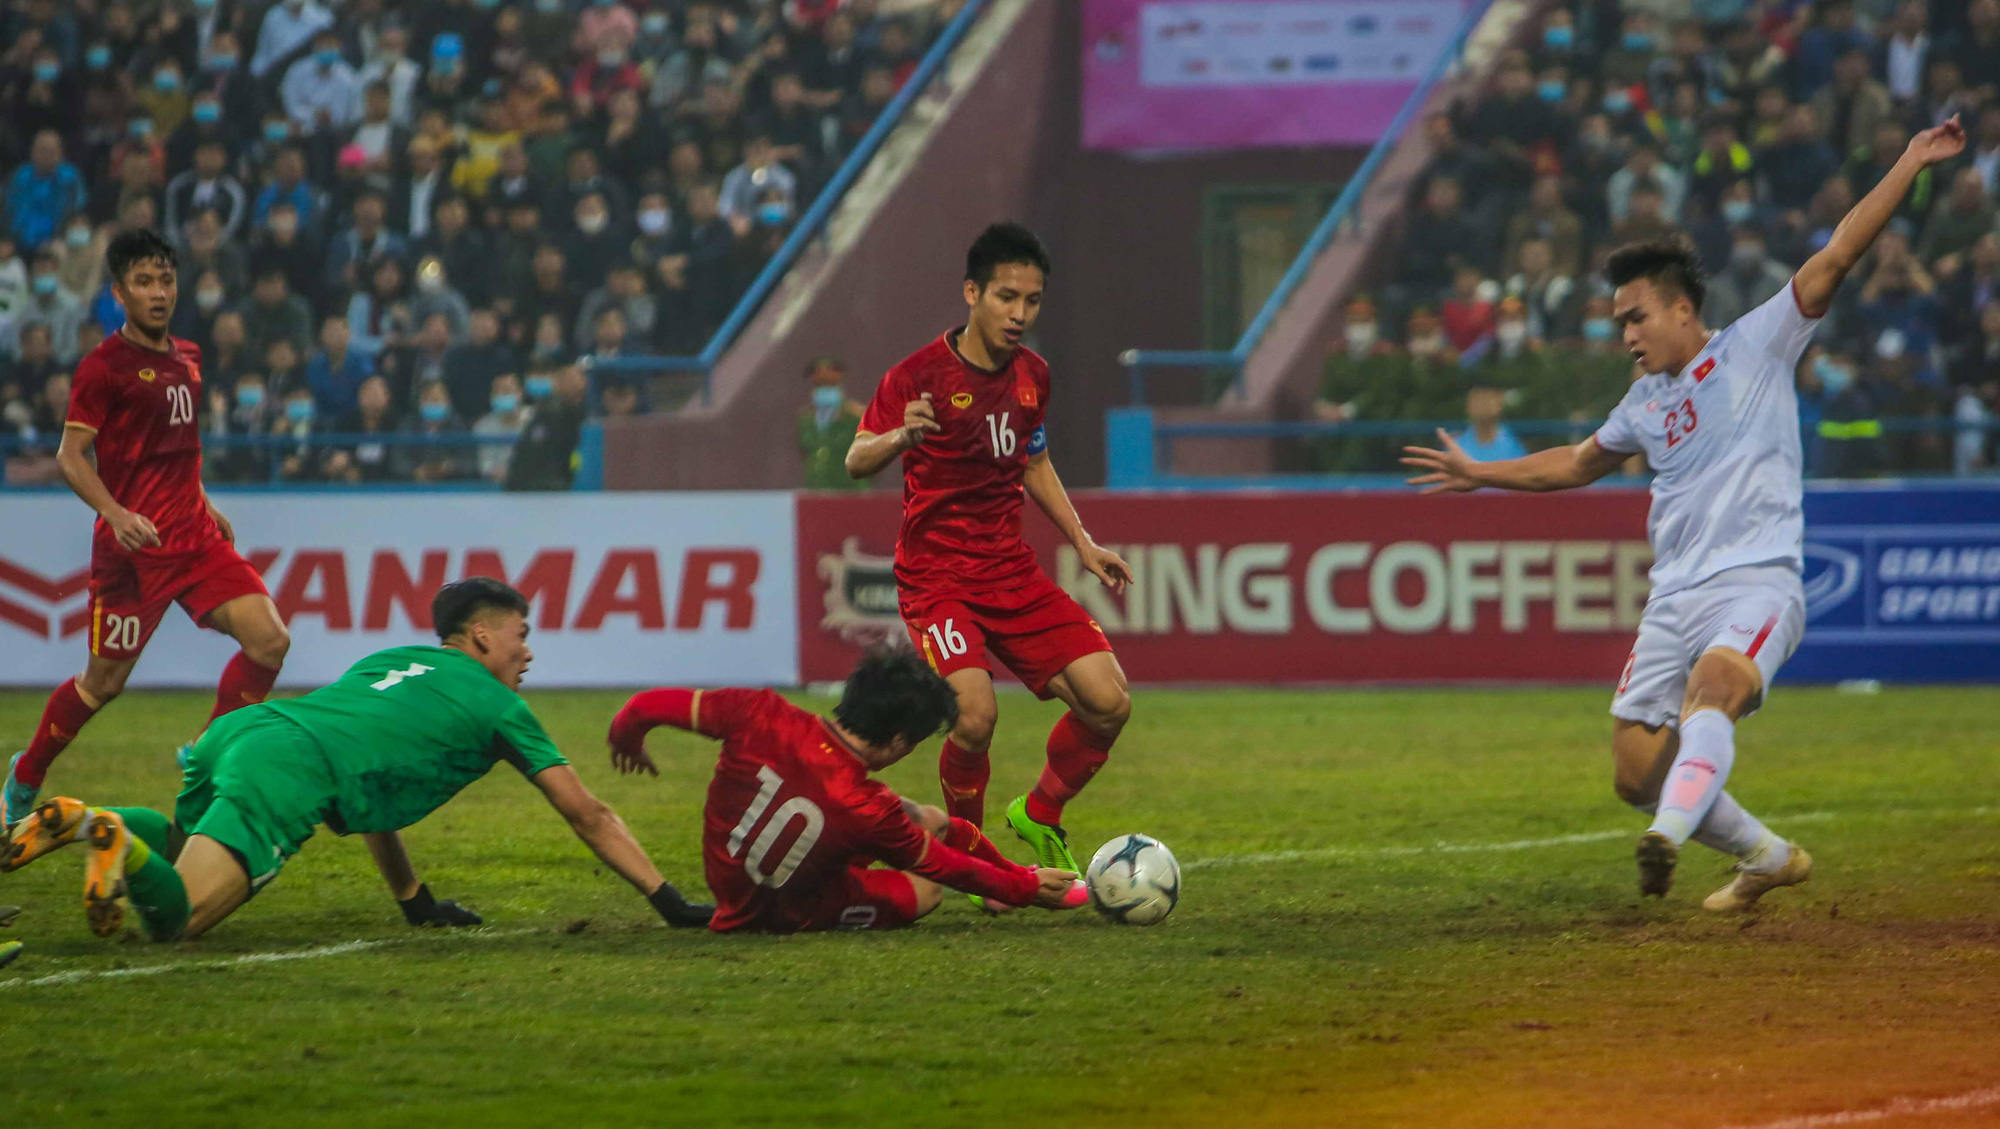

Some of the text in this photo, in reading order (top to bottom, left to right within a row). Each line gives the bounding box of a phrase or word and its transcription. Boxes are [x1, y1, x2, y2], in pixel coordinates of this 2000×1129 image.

[166, 384, 193, 425] 20
[1664, 398, 1698, 449] 23
[985, 411, 1016, 458] 16
[1056, 543, 1292, 634] KING
[104, 613, 140, 651] 20
[927, 618, 968, 661] 16
[369, 662, 436, 691] 1
[726, 764, 825, 889] 10
